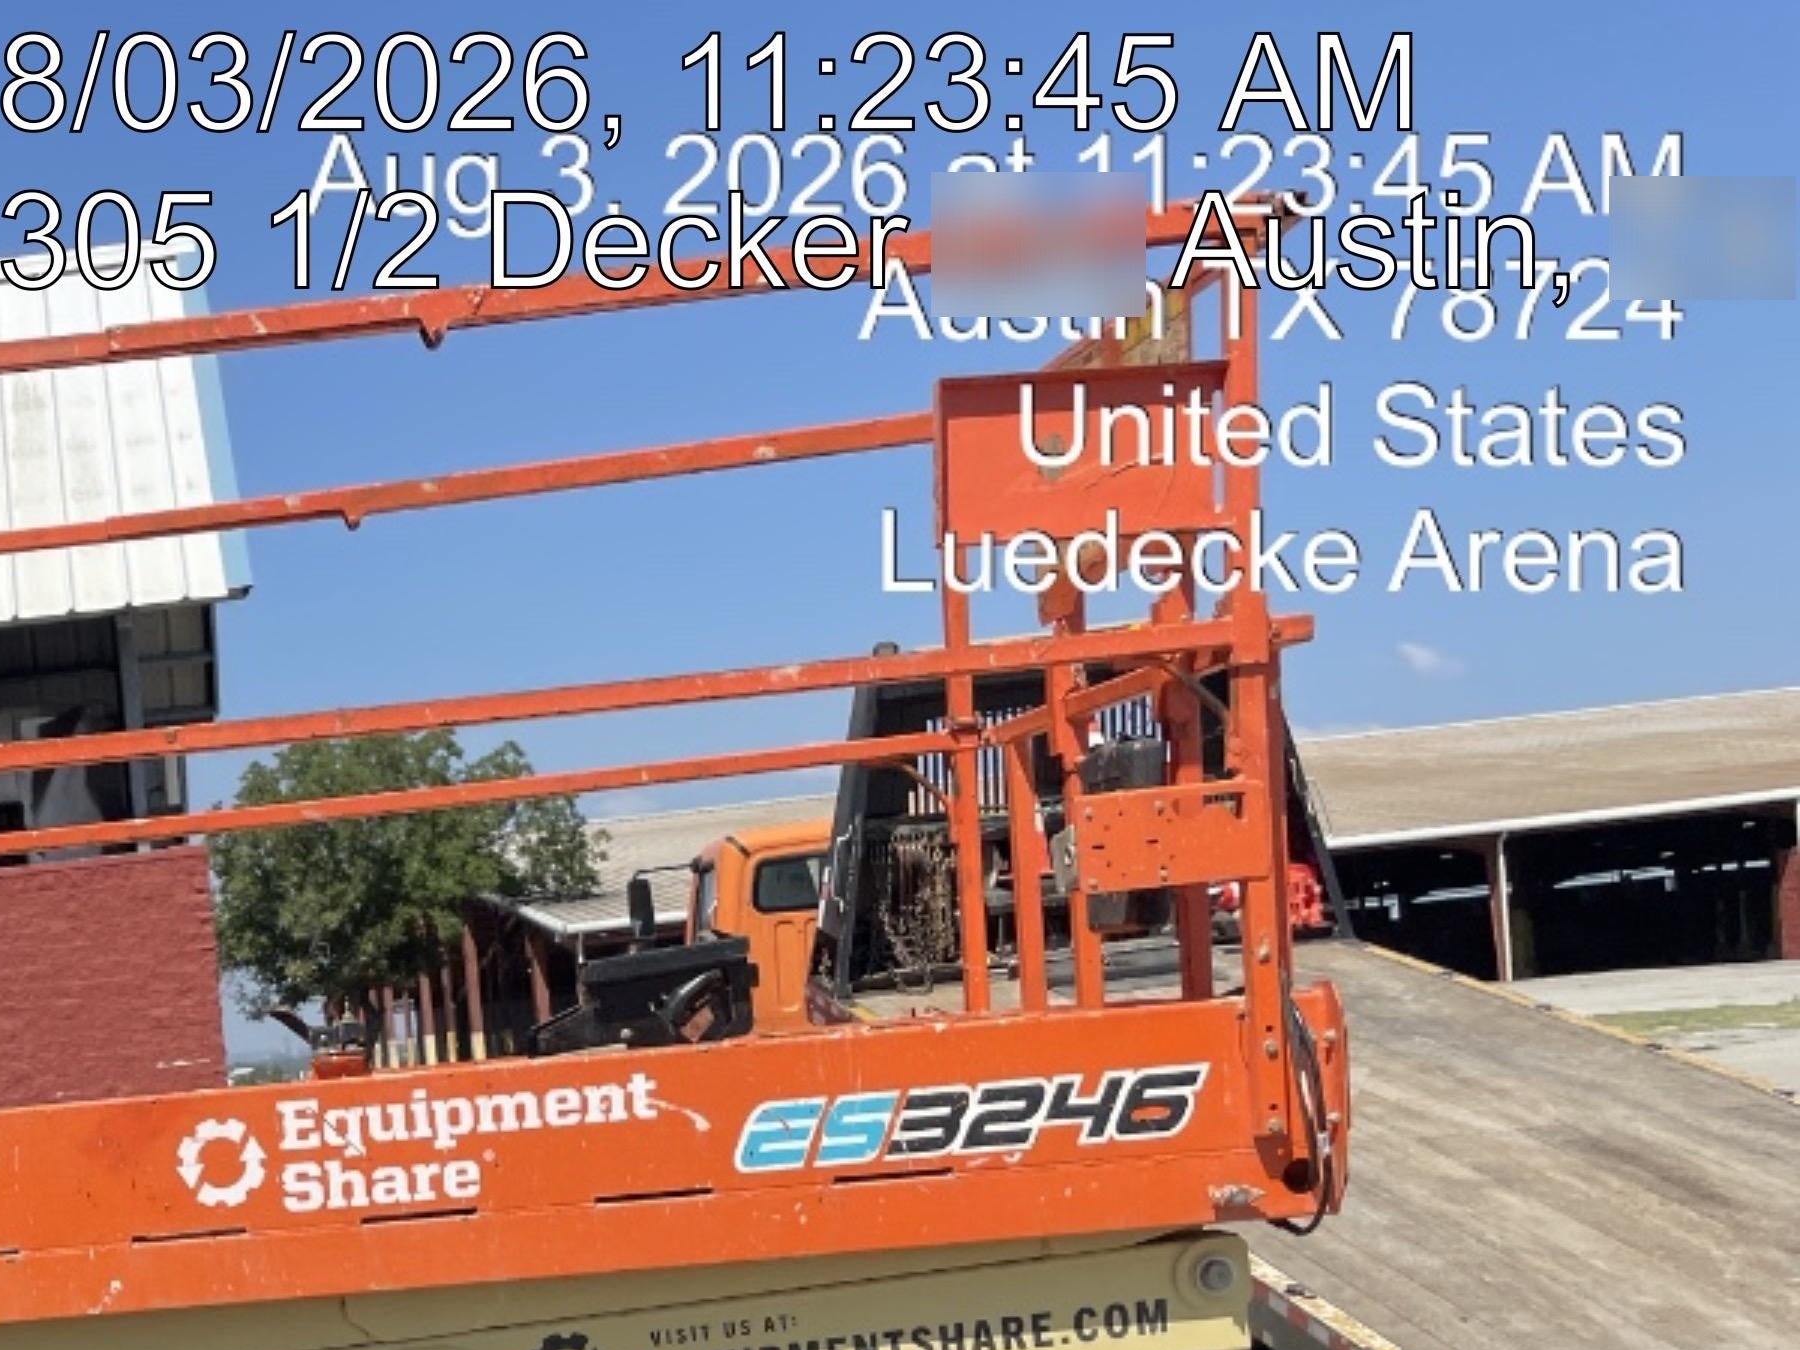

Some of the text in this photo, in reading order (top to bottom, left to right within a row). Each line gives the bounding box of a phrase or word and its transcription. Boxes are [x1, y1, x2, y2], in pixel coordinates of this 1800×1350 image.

[277, 1072, 657, 1156] Equipment
[734, 1062, 1210, 1174] ES3246
[280, 1157, 481, 1213] Share
[650, 1325, 709, 1347] VISIT
[723, 1320, 751, 1339] US
